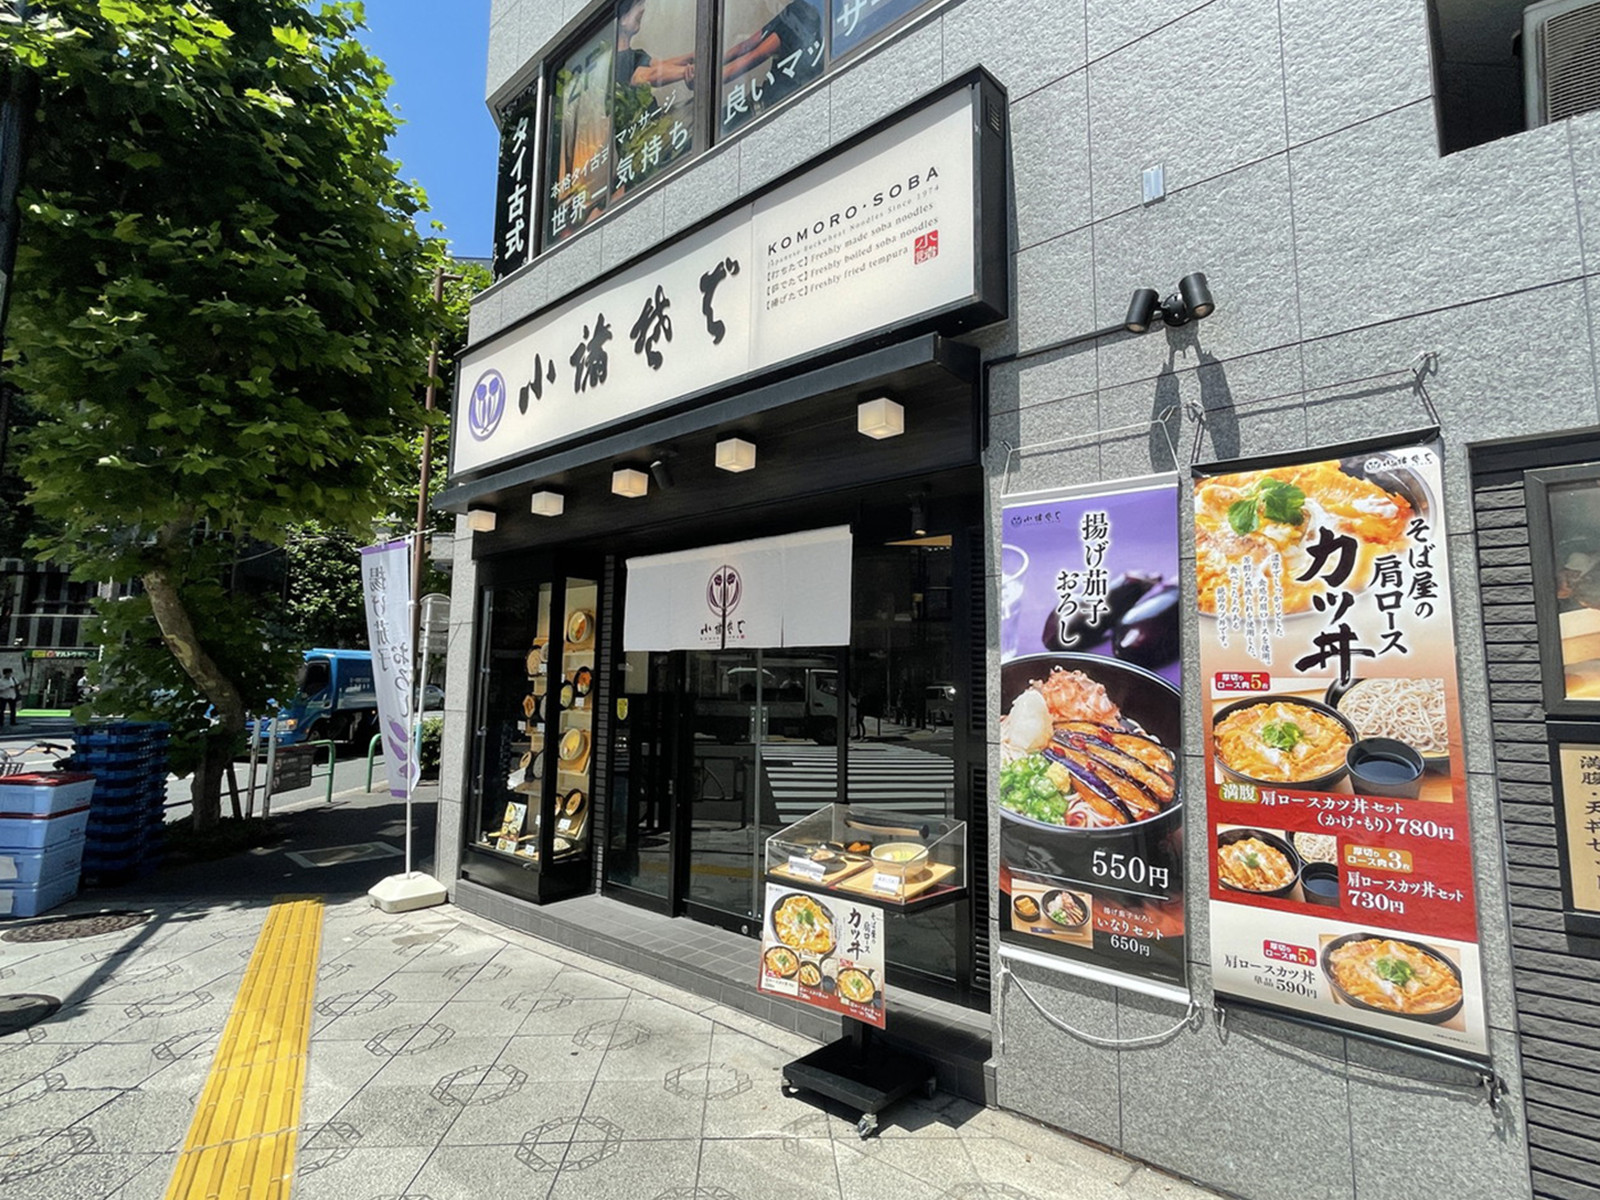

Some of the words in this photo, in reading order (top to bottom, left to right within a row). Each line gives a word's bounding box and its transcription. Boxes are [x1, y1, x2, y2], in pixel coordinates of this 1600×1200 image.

[505, 117, 528, 260] タイ古式
[844, 231, 868, 248] made
[871, 221, 892, 237] soba
[895, 203, 934, 225] noodles
[844, 245, 873, 263] boiled
[875, 234, 897, 250] soba
[900, 217, 939, 239] noodles
[844, 262, 866, 279] fried
[869, 246, 908, 268] tempura
[1082, 513, 1109, 625] 揚げ茄子
[1406, 518, 1438, 619] そば屋の
[1056, 571, 1079, 644] おろし
[1295, 526, 1376, 686] カツ丼
[1369, 555, 1408, 655] 肩ロース
[1222, 784, 1256, 801] 満腹
[1395, 818, 1454, 840] 780円
[1092, 851, 1169, 889] 550円
[1347, 871, 1464, 902] 肩ロースカツ丼セット
[1348, 890, 1404, 914] 730円
[846, 907, 864, 960] カツ丼
[1097, 917, 1164, 941] いなりセット
[1110, 934, 1150, 957] 650円
[1224, 954, 1316, 984] 肩ロースカツ丼
[1276, 979, 1317, 999] 590円
